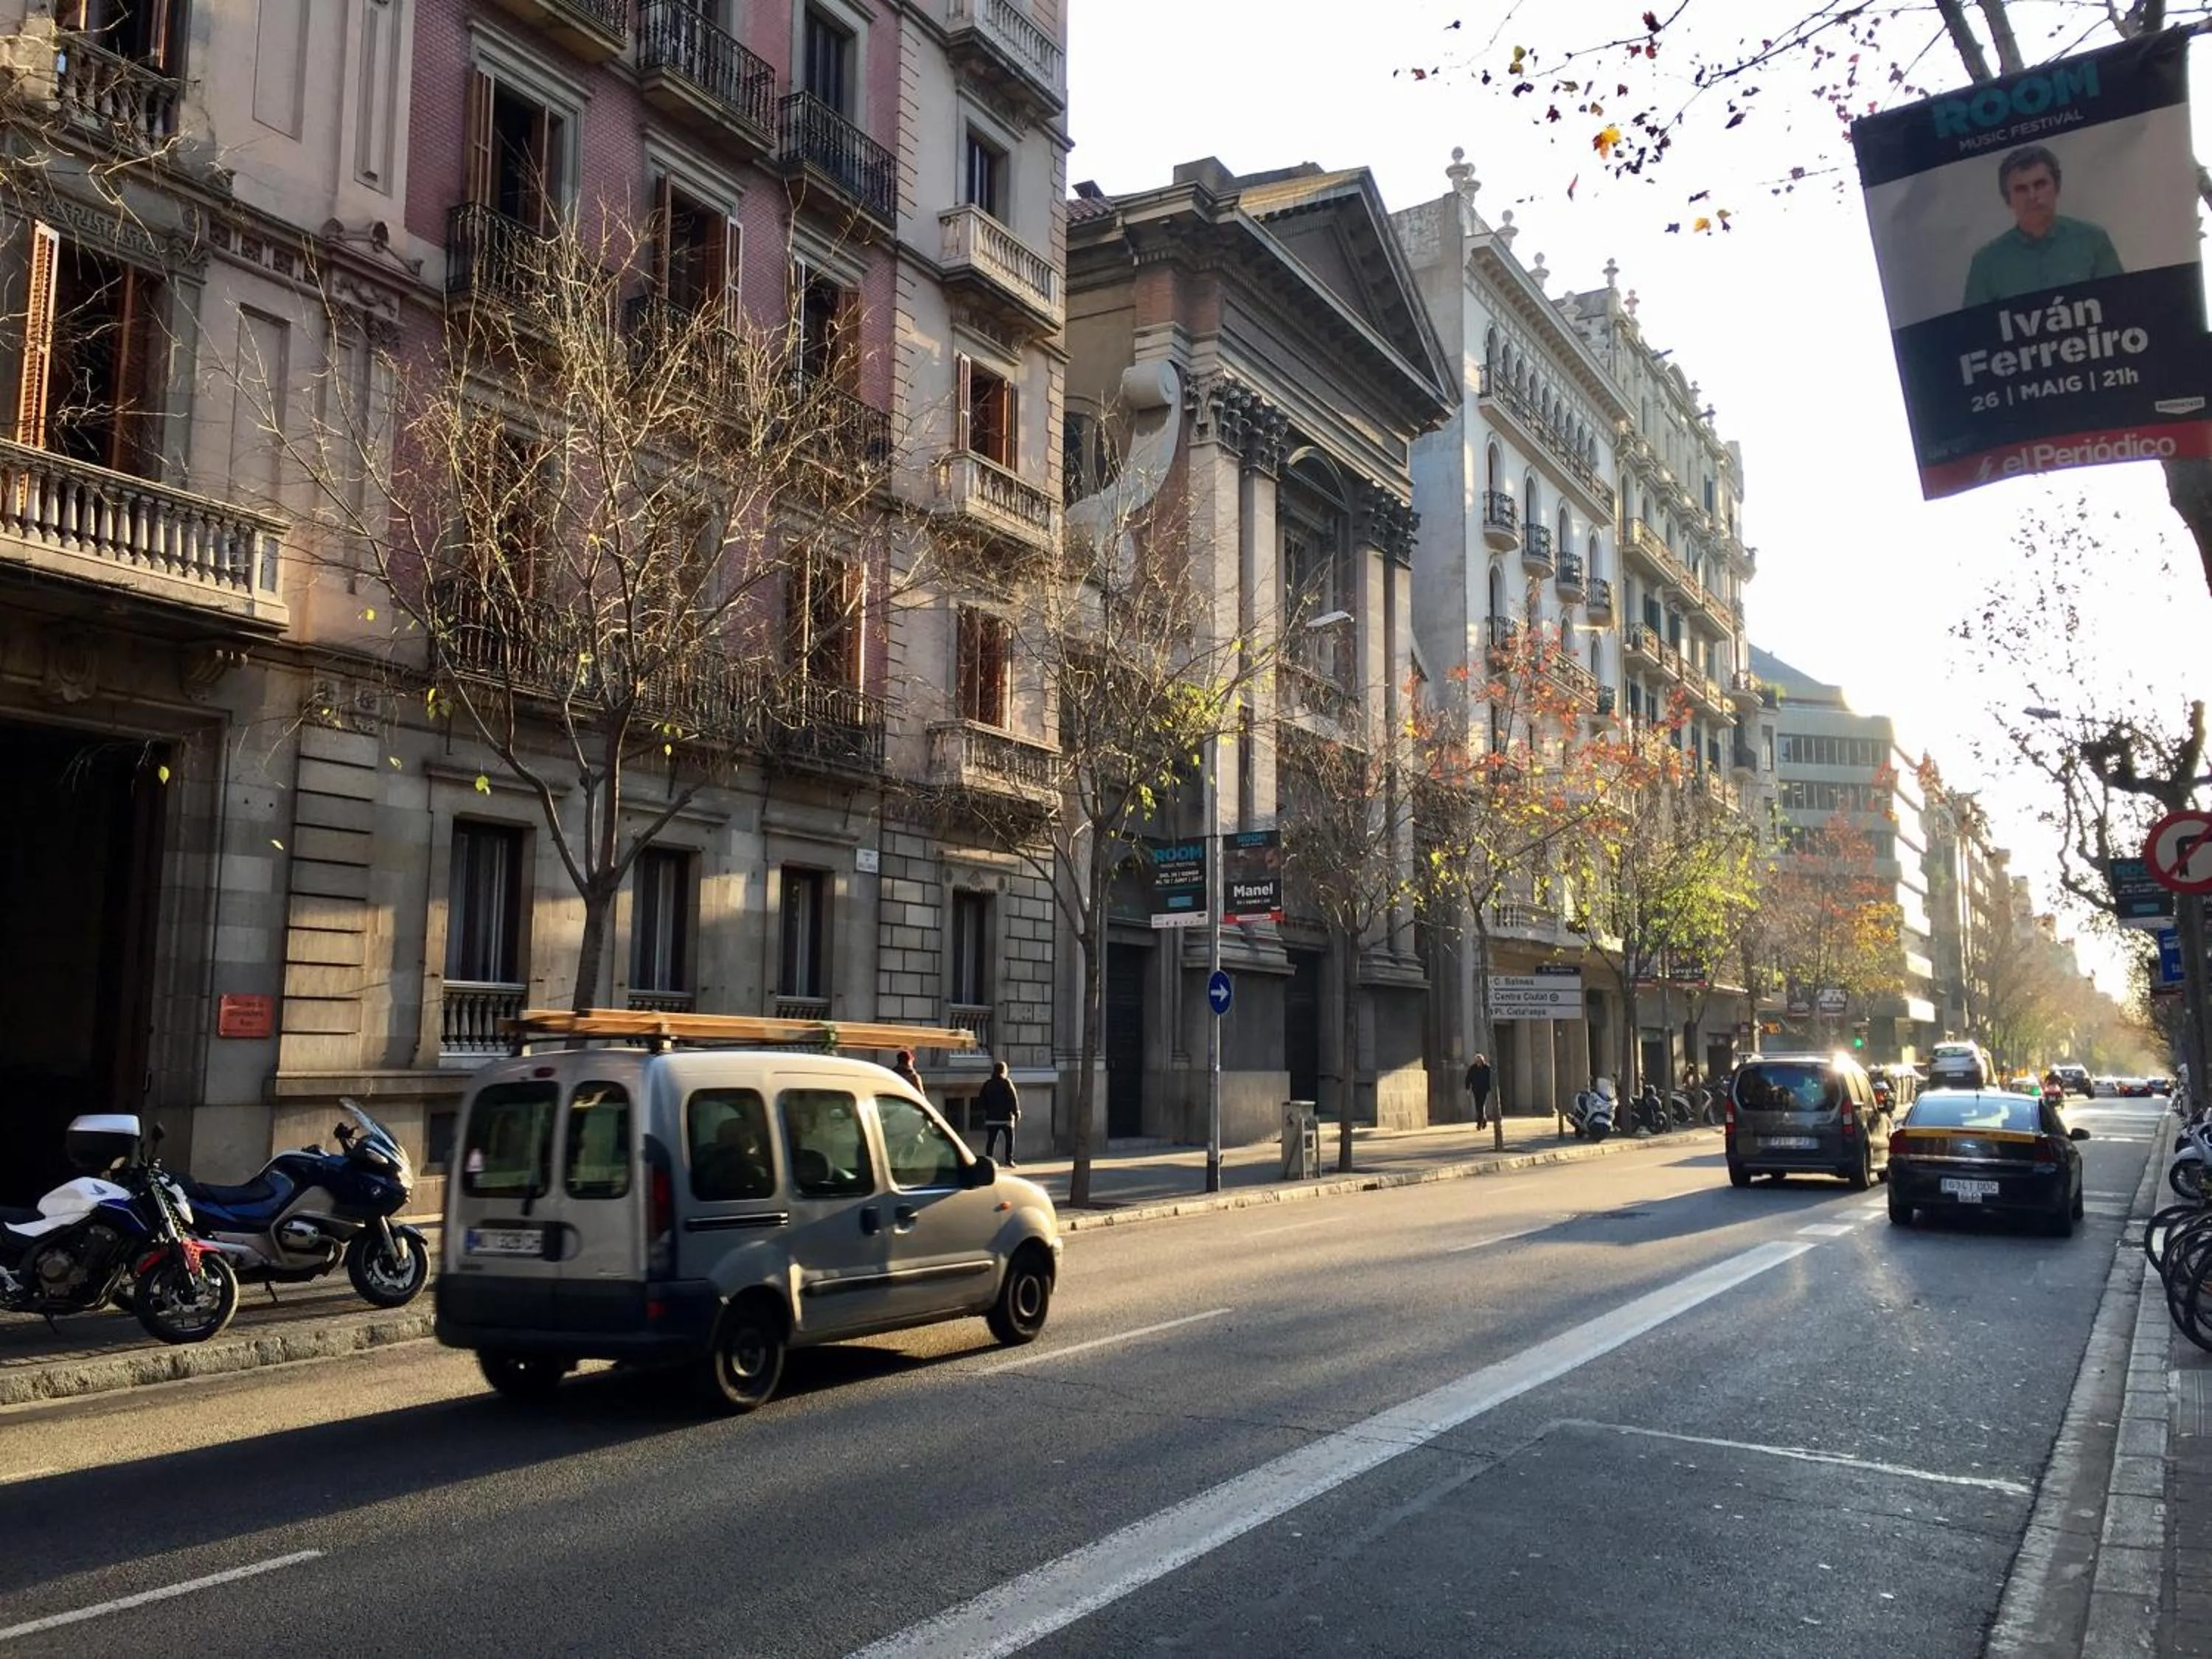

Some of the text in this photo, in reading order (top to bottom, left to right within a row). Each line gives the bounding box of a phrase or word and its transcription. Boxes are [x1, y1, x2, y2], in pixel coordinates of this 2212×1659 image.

[1932, 60, 2100, 139] ROOM
[1958, 108, 2084, 151] MUSIC FESTIVAL
[1999, 295, 2102, 342] Iván
[1959, 327, 2149, 386] Ferreiro
[1971, 391, 2000, 413] 26
[2019, 374, 2083, 400] MAIG
[2102, 366, 2139, 387] 21h
[1155, 846, 1203, 863] ROOM
[1234, 883, 1273, 897] Manel
[1523, 992, 1548, 1001] Ciutat
